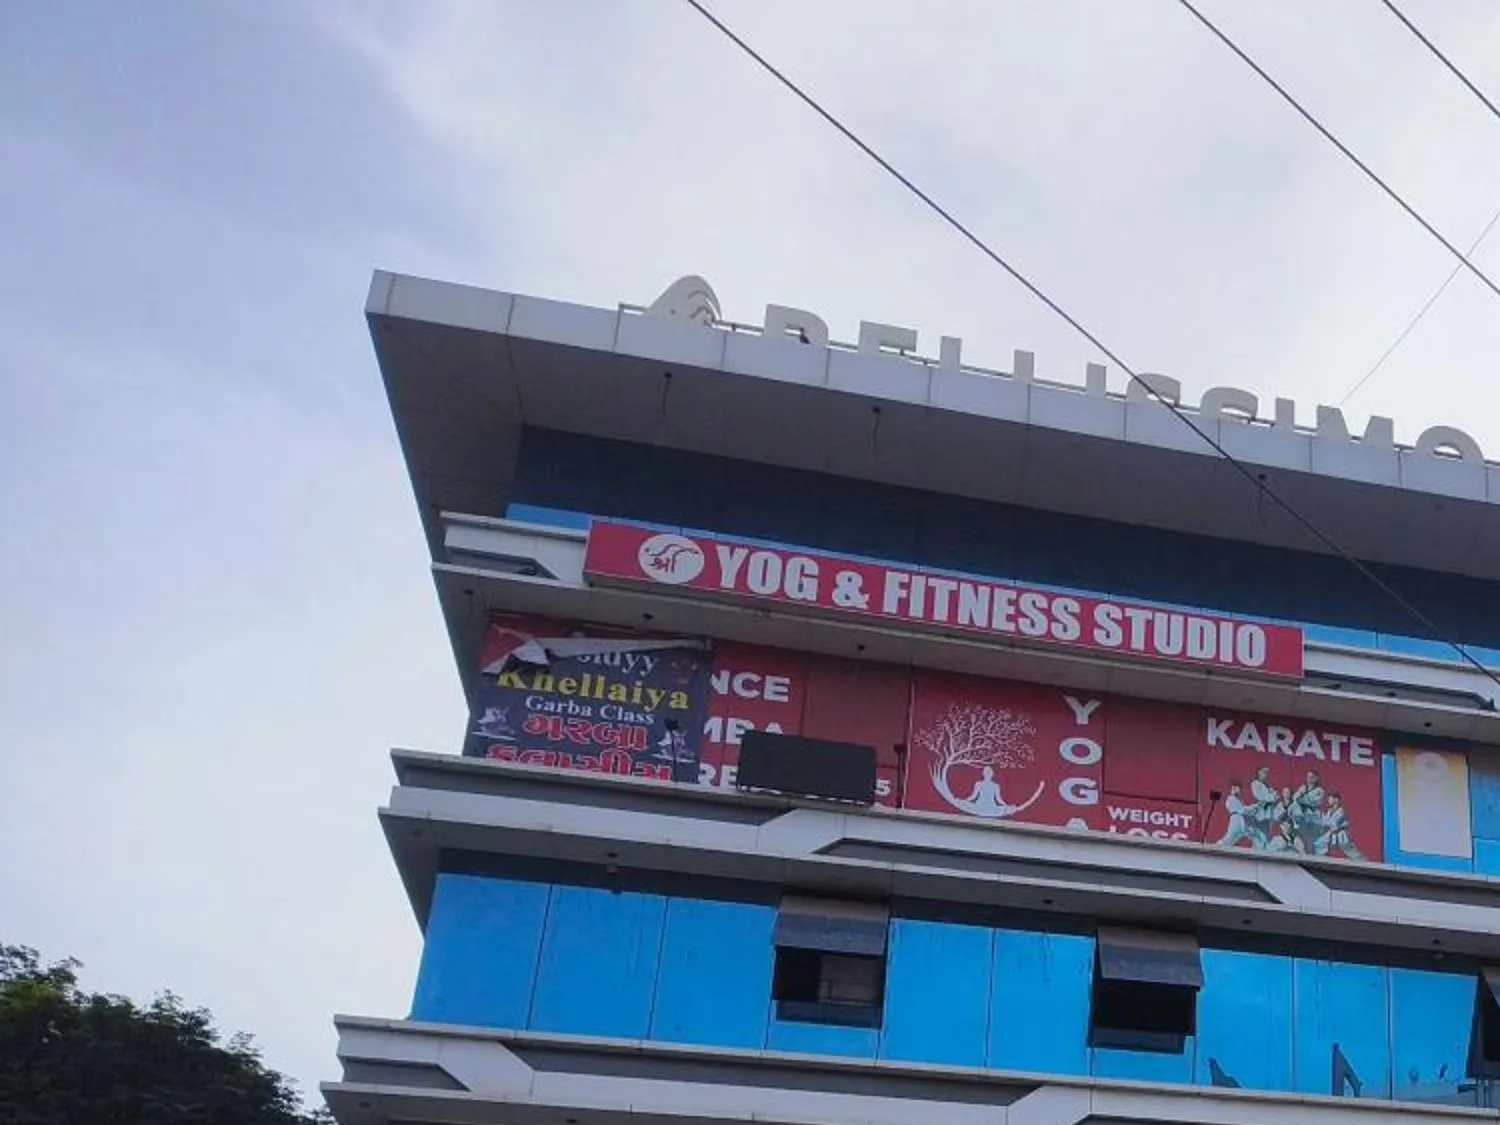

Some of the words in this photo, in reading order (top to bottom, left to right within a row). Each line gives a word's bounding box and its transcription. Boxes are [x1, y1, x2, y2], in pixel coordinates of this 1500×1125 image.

[715, 543, 820, 602] YOG
[831, 571, 870, 610] &
[884, 570, 1080, 642] FITNESS
[1092, 602, 1267, 668] STUDIO
[710, 670, 791, 703] NCE
[525, 695, 592, 717] Garba
[600, 704, 656, 725] Class
[522, 714, 649, 751] ગરબા
[1206, 717, 1376, 767] KARATE
[1106, 806, 1192, 828] WEIGHT
